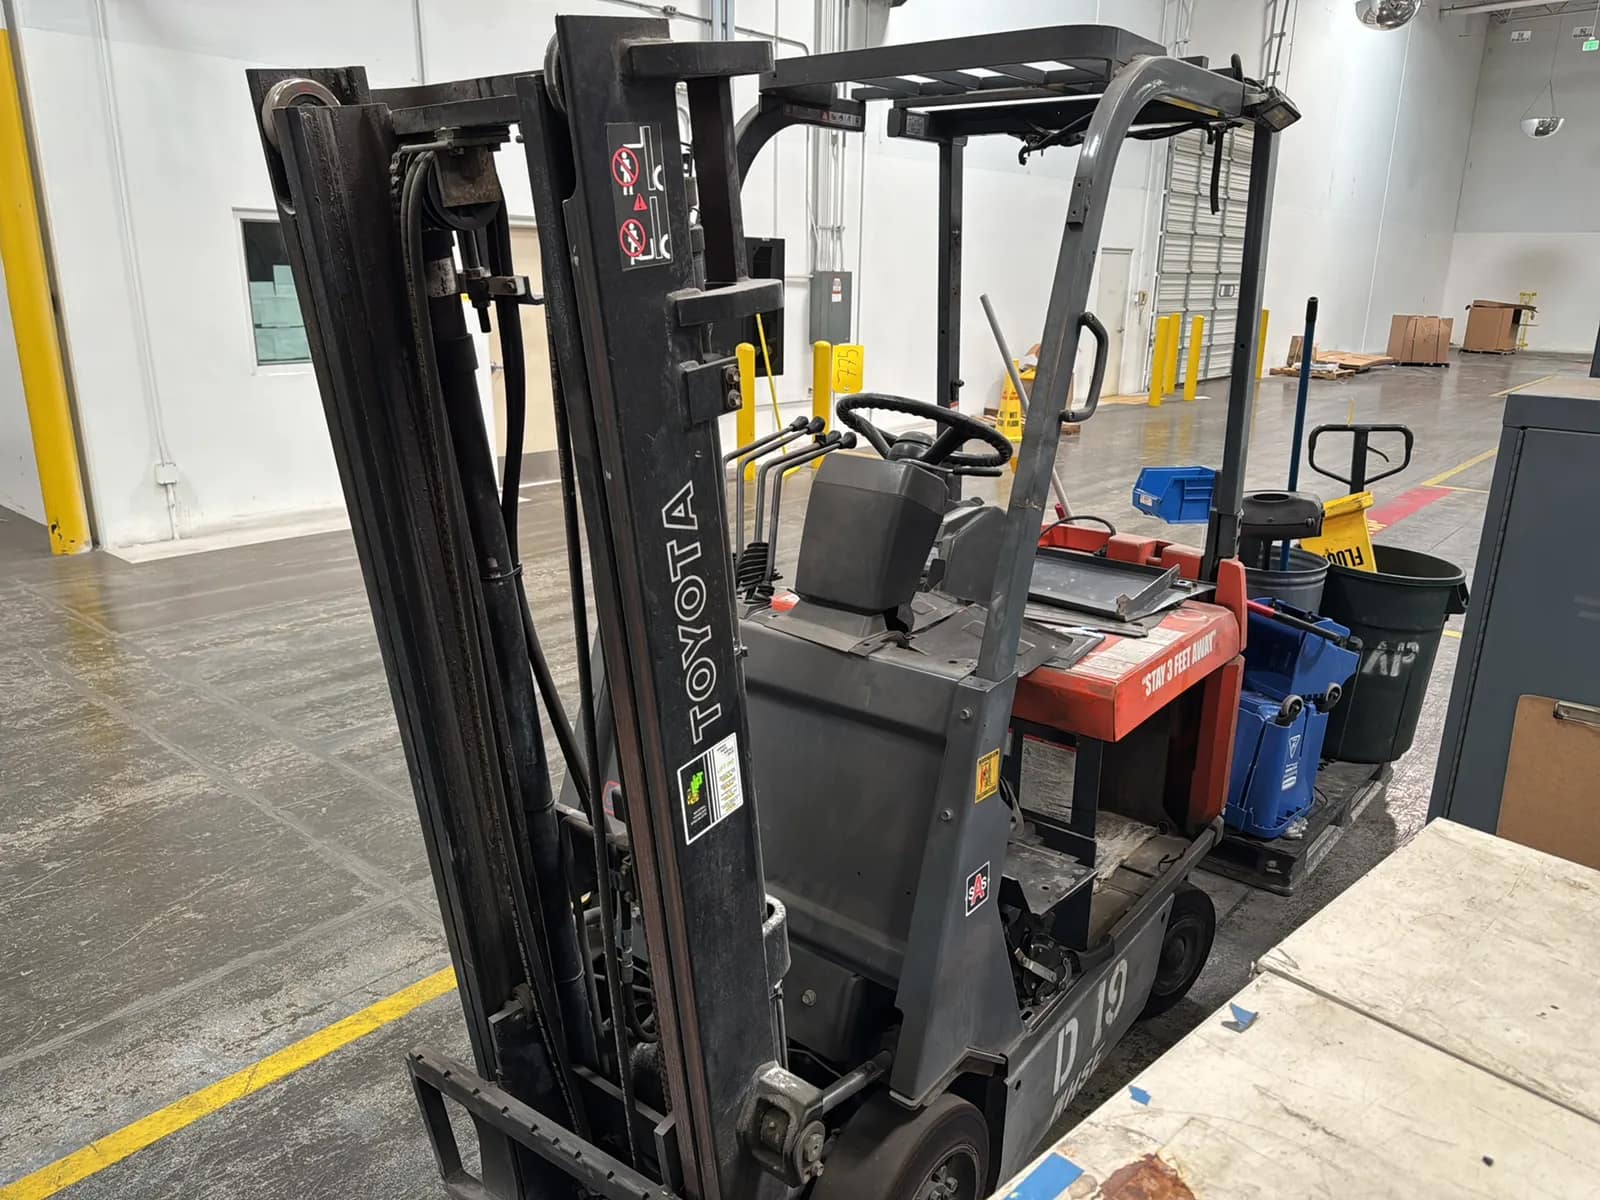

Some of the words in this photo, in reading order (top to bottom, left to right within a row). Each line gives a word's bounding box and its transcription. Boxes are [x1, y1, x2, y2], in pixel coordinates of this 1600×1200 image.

[661, 480, 722, 745] TOYOTA
[1167, 658, 1173, 682] 3
[1174, 646, 1191, 677] FEET
[1053, 1016, 1079, 1096] D
[1092, 959, 1128, 1048] 19
